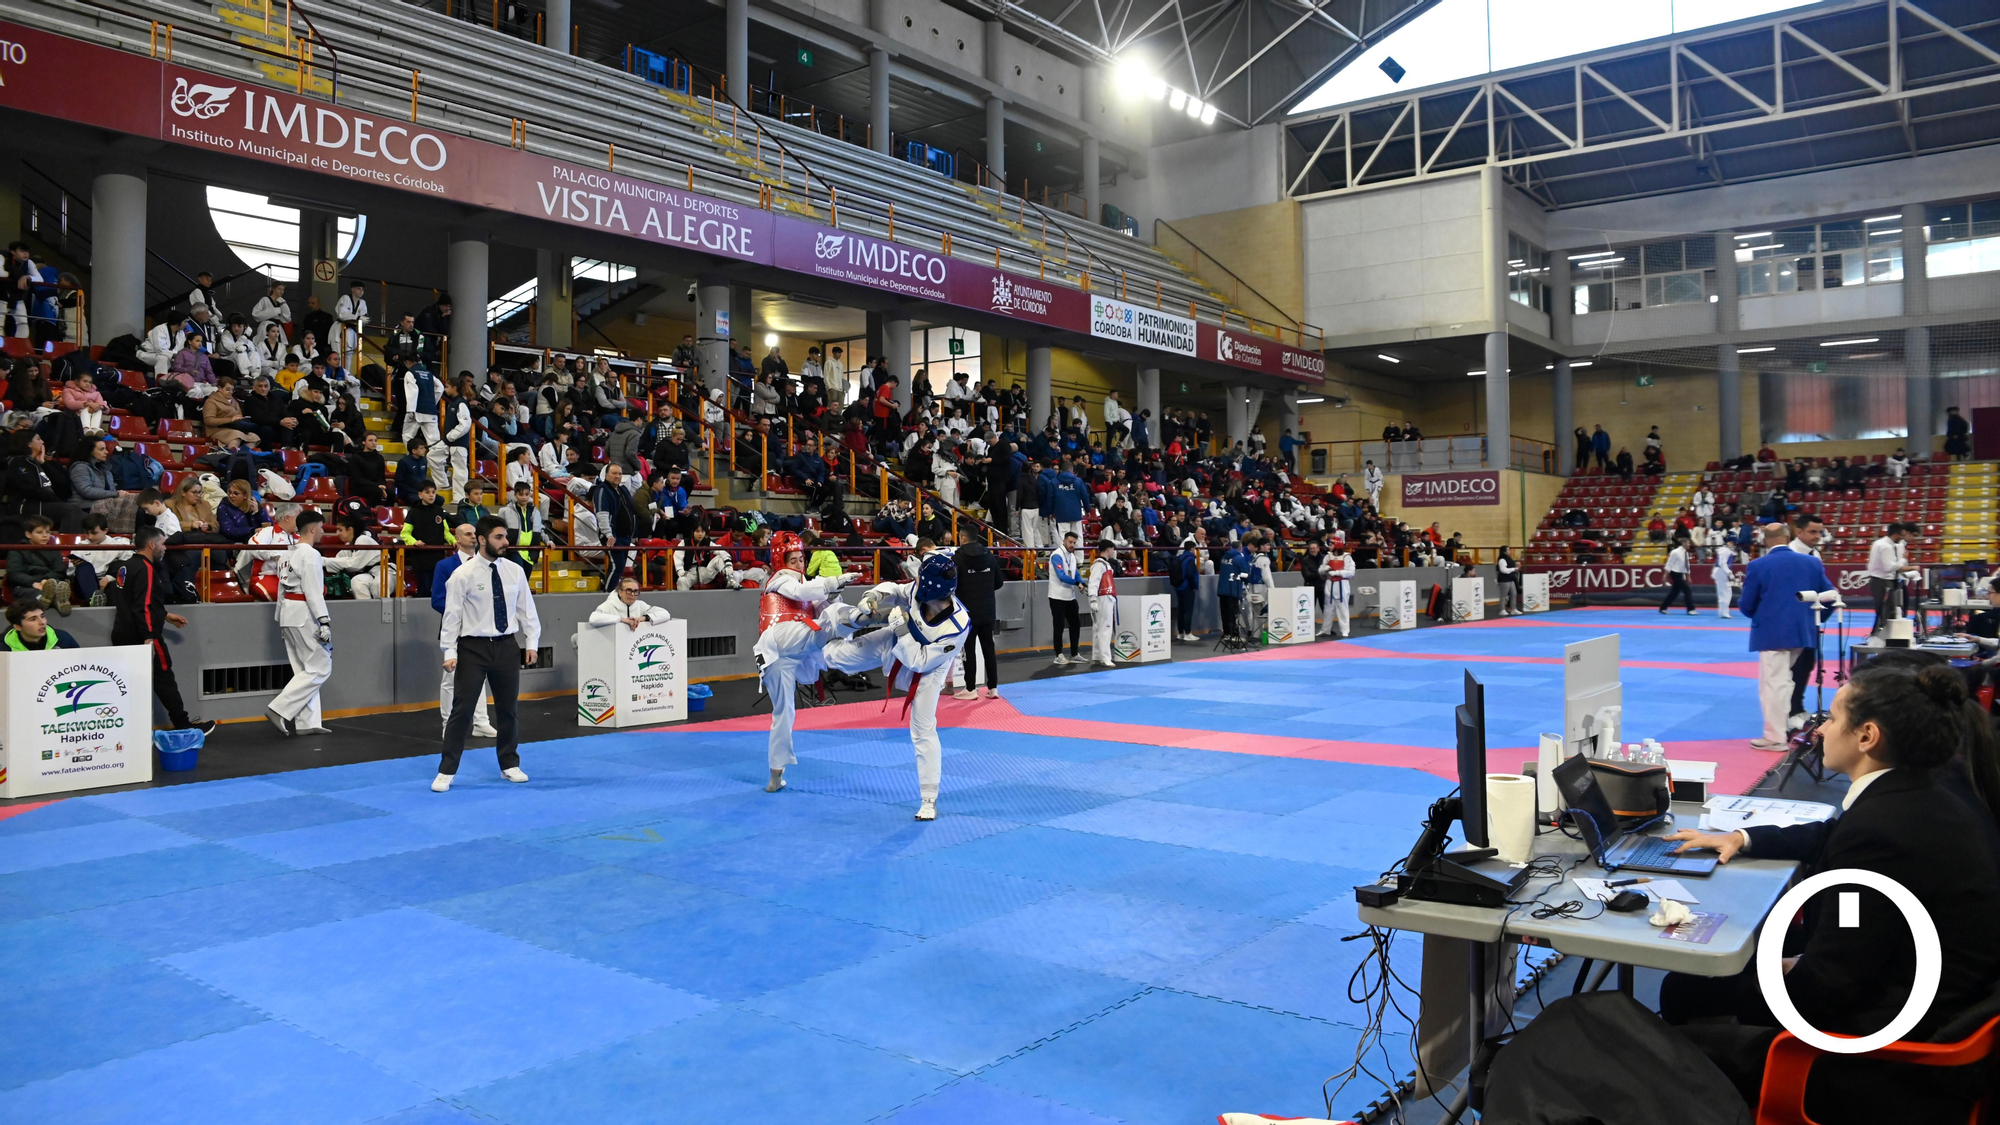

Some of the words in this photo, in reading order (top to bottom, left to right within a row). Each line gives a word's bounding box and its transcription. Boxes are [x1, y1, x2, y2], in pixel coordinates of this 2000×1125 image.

[801, 52, 808, 63] 4
[244, 90, 447, 171] IMDECO
[172, 123, 234, 148] Instituto
[238, 138, 307, 164] Municipal
[311, 156, 328, 169] de
[332, 159, 390, 182] Deportes
[394, 172, 445, 193] Córdoba
[553, 165, 610, 190] PALACIO
[613, 180, 680, 207] MUNICIPAL
[683, 197, 739, 220] DEPORTES
[536, 181, 630, 231] VISTA
[640, 206, 754, 256] ALEGRE
[848, 236, 946, 284] IMDECO
[815, 263, 844, 277] Instituto
[846, 270, 878, 285] Municipal
[879, 278, 889, 287] de
[890, 279, 918, 293] Deportes
[919, 286, 946, 299] Córdoba
[1013, 284, 1052, 304] AYUNTAMIENTO
[1013, 297, 1021, 309] DE
[1021, 298, 1047, 315] CÓRDOBA
[1094, 320, 1132, 339] CÓRDOBA
[1138, 312, 1188, 335] PATRIMONIO
[953, 341, 961, 352] D
[1138, 327, 1194, 352] HUMANIDAD
[1234, 341, 1262, 356] Diputación
[1234, 352, 1241, 361] de
[1242, 353, 1262, 366] Córdoba
[1292, 352, 1324, 373] IMDECO
[1641, 376, 1648, 385] K
[1425, 478, 1496, 495] IMDECO
[1576, 568, 1686, 588] IMDEC
[628, 633, 655, 661] FEDERACION
[655, 633, 676, 658] ANDALUZA
[36, 664, 87, 703] FEDERACION
[89, 664, 128, 697] ANDALUZA
[631, 672, 674, 683] TAEKWONDO
[641, 682, 664, 690] Hapkido
[41, 717, 124, 735] TAEKWONDO
[60, 732, 105, 744] Hapkido
[41, 762, 125, 777] www.fataekwondo.org
